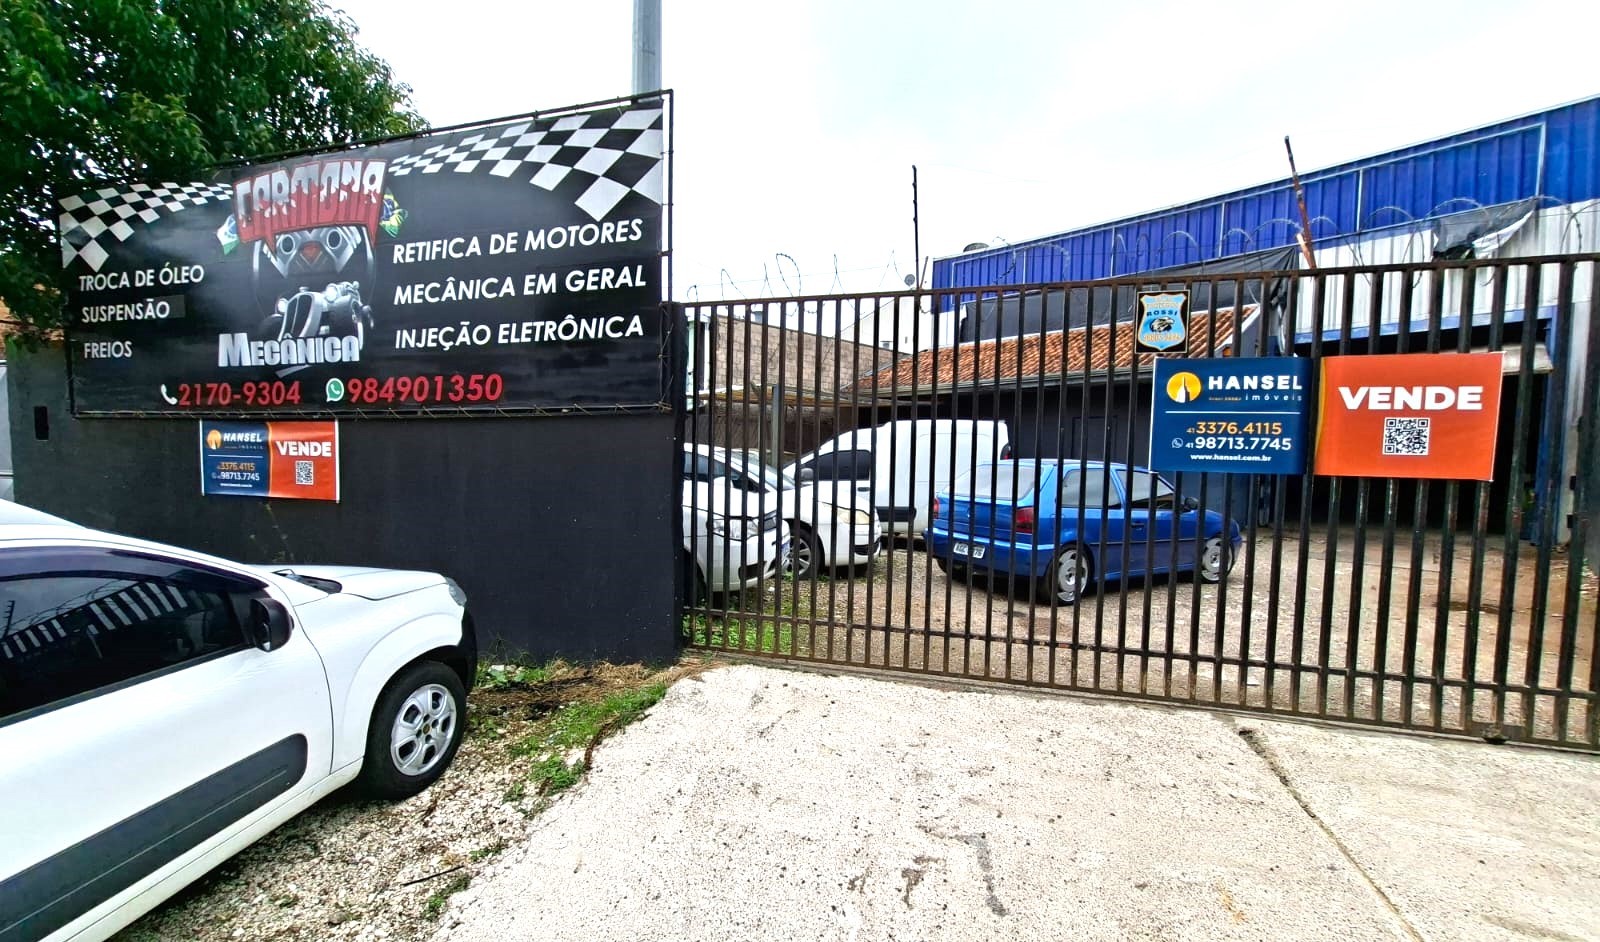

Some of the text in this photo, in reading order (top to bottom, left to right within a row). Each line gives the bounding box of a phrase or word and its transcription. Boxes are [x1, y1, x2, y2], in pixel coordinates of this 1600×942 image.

[392, 218, 643, 264] RETIFICA DE MOTORES
[79, 261, 205, 291] TROCA DE ÓLEO
[393, 264, 647, 305] MECÂNICA EM GERAL
[81, 298, 171, 323] SUSPENSÃO
[1146, 309, 1179, 317] ROSSI
[395, 315, 644, 351] INJEÇÃO ELETRÔNICA
[83, 340, 133, 359] FREIOS
[347, 373, 503, 403] 984901350
[1208, 375, 1303, 390] HANSEL
[178, 380, 301, 406] 2170-9304
[1244, 393, 1303, 401] imóveis
[1338, 386, 1484, 410] VENDE
[223, 432, 262, 443] HANSEL
[1195, 421, 1283, 435] 3376.4115
[276, 441, 332, 457] VENDE
[1194, 436, 1293, 451] 98713.7745
[1190, 454, 1272, 462] www.hansel.com.br
